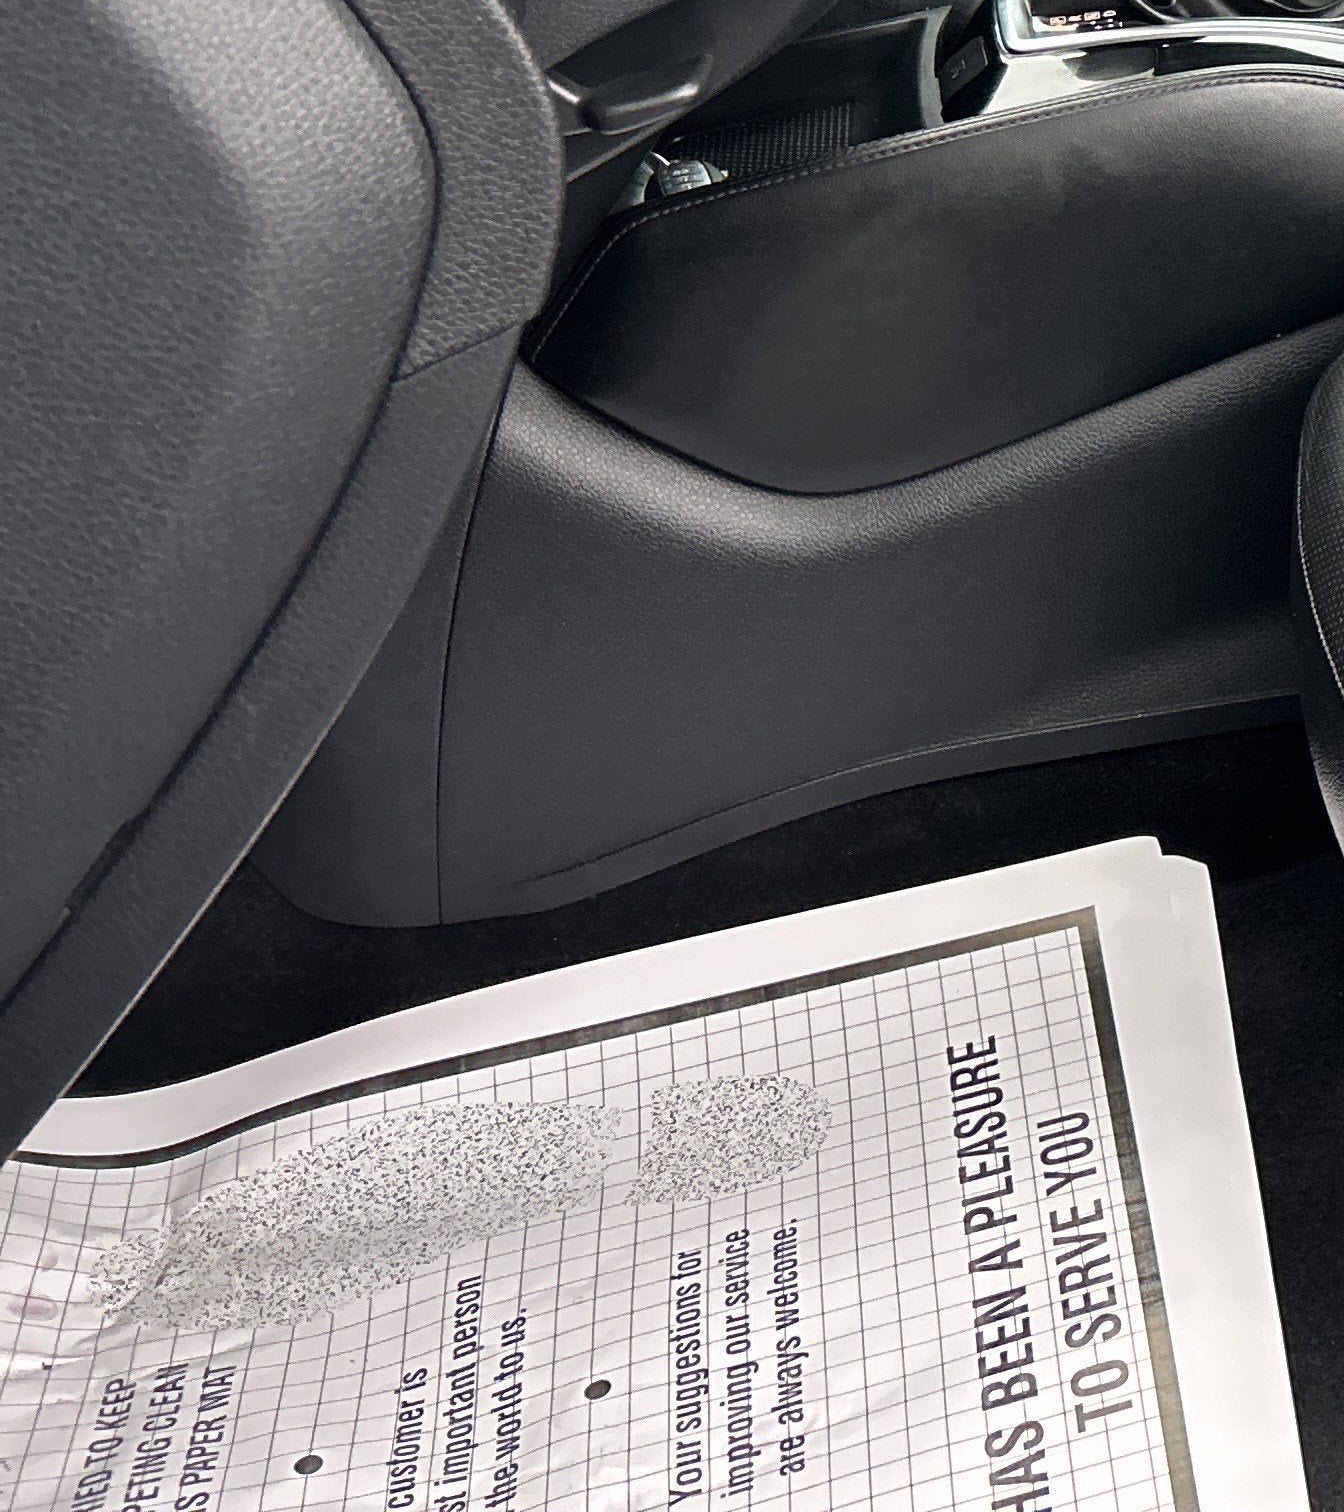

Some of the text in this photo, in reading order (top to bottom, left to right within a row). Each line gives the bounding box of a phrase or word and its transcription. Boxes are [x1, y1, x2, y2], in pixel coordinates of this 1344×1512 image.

[946, 1034, 1018, 1236] PLEASURE
[453, 1274, 484, 1360] person
[968, 1238, 1024, 1275] A
[1036, 1112, 1133, 1434] TO SERVE YOU
[94, 1378, 137, 1432] KEEP
[142, 1363, 189, 1432] CLEAN
[197, 1365, 236, 1413] MAT
[484, 1308, 528, 1509] the world to us.
[668, 1249, 709, 1508] Your suggestions for
[718, 1229, 762, 1500] improving our service
[767, 1218, 809, 1477] are always welcome.
[971, 1284, 1039, 1411] BEEN
[84, 1437, 124, 1468] TO
[180, 1414, 227, 1487] PAPER
[386, 1367, 428, 1510] customer is
[434, 1361, 479, 1487] important
